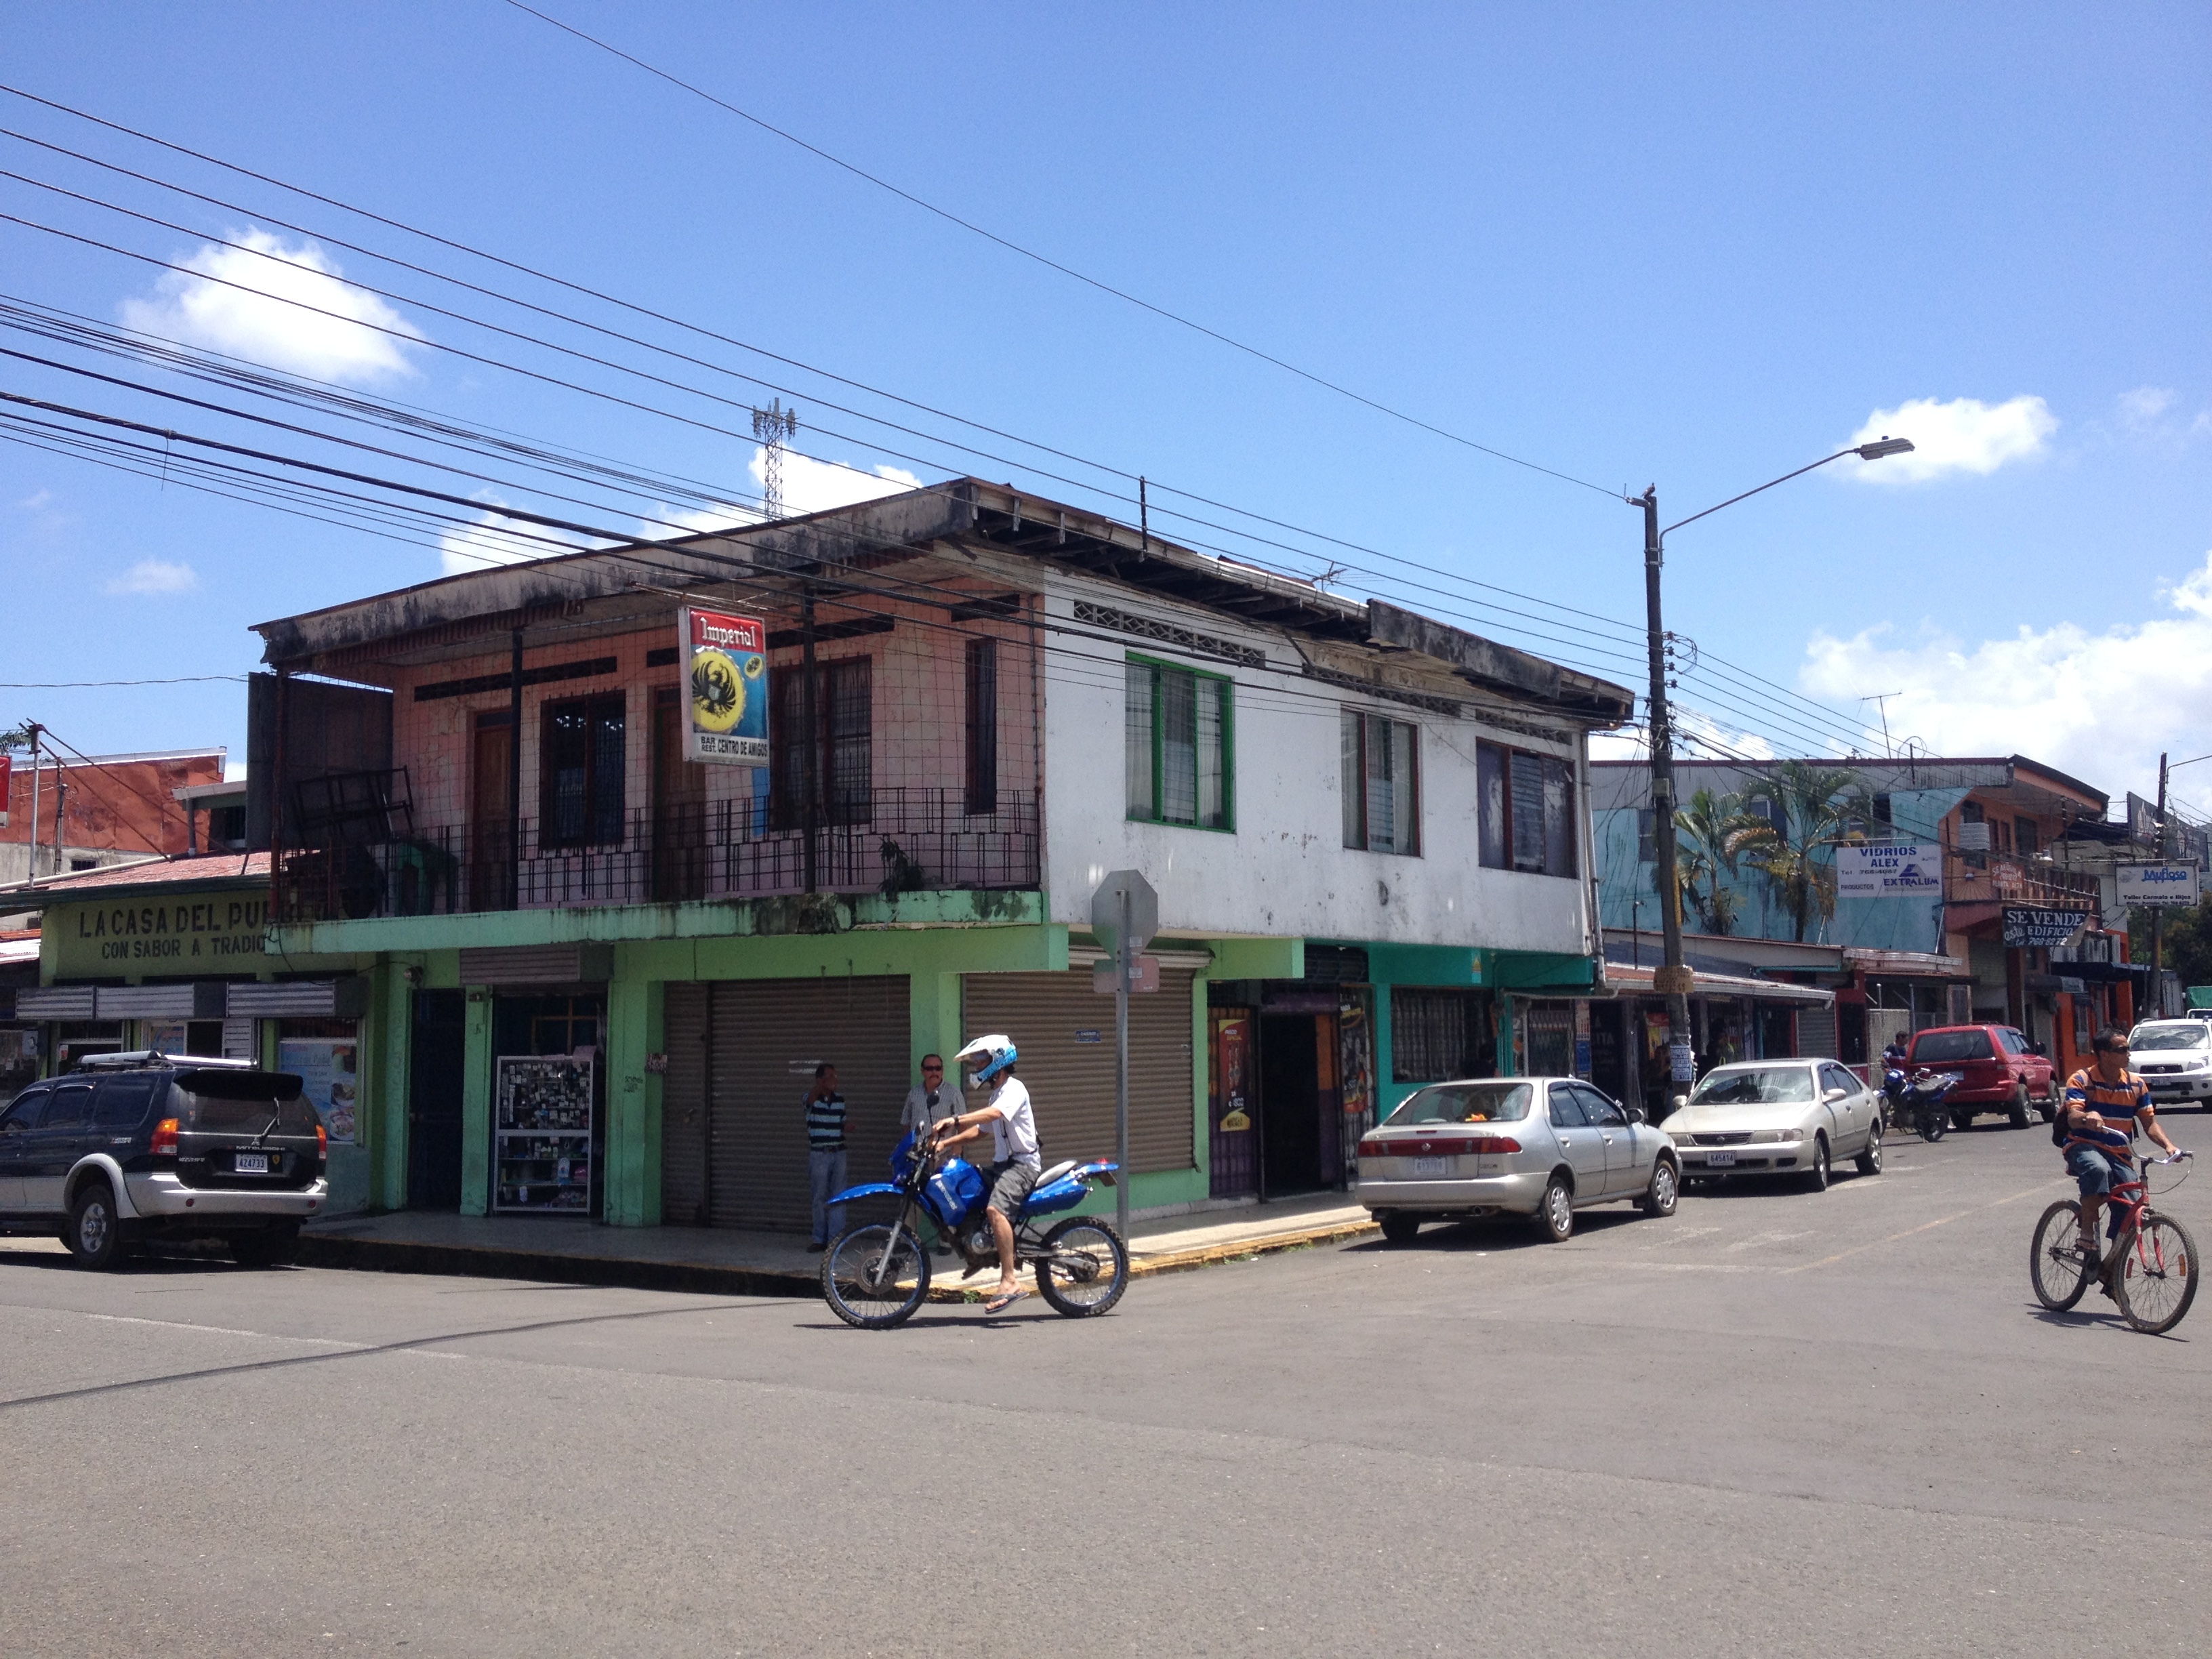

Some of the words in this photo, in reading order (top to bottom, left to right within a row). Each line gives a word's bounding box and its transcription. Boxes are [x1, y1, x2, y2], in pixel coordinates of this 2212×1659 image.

[699, 617, 756, 647] Imperial
[701, 736, 715, 744] BAR
[718, 739, 739, 754] CENTRO
[740, 741, 747, 755] DE
[748, 742, 767, 757] AMIGOS
[1860, 847, 1917, 857] VIDRIOS
[1870, 859, 1899, 867] ALEX
[1883, 878, 1939, 886] EXTRALUM
[80, 909, 105, 938] LA
[111, 907, 167, 935] CASA
[176, 903, 222, 933] DEL
[2007, 911, 2028, 924] SE
[2031, 912, 2085, 926] VENDE
[102, 941, 129, 959] CON
[134, 939, 181, 958] SABOR
[192, 938, 201, 956] A
[239, 1158, 264, 1168] 424733
